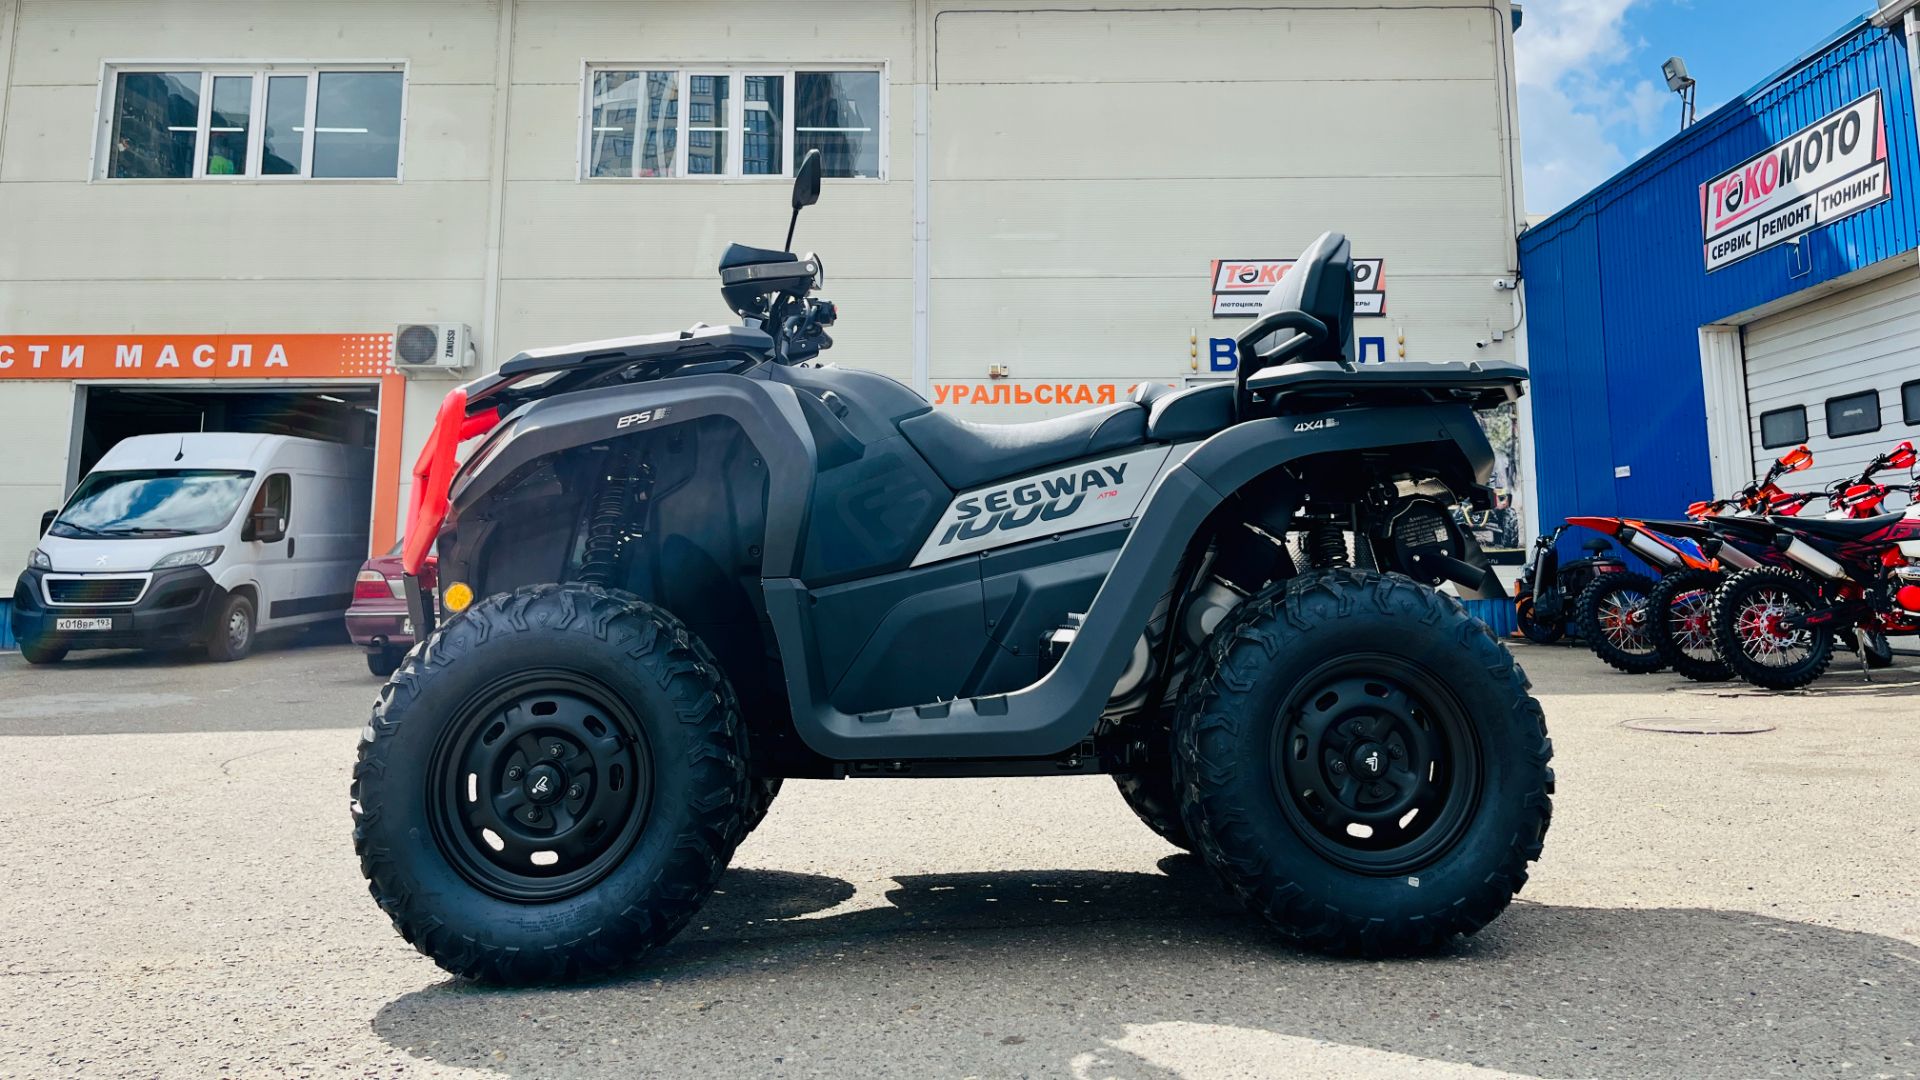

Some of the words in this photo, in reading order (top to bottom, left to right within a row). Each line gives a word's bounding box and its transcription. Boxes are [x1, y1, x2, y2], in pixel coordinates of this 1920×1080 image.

[1713, 110, 1861, 218] ТОКОМОТО
[1711, 230, 1752, 260] СЕРВИС
[1762, 203, 1812, 239] РЕМОНТ
[1820, 172, 1880, 213] ТЮНИНГ
[0, 345, 84, 368] СТИ
[115, 344, 288, 368] МАСЛА
[445, 329, 456, 359] ZANUSSI
[934, 384, 1116, 405] УРАЛЬСКАЯ
[616, 411, 652, 429] EPS
[956, 462, 1128, 521] SEGWAY
[938, 494, 1087, 546] 1000
